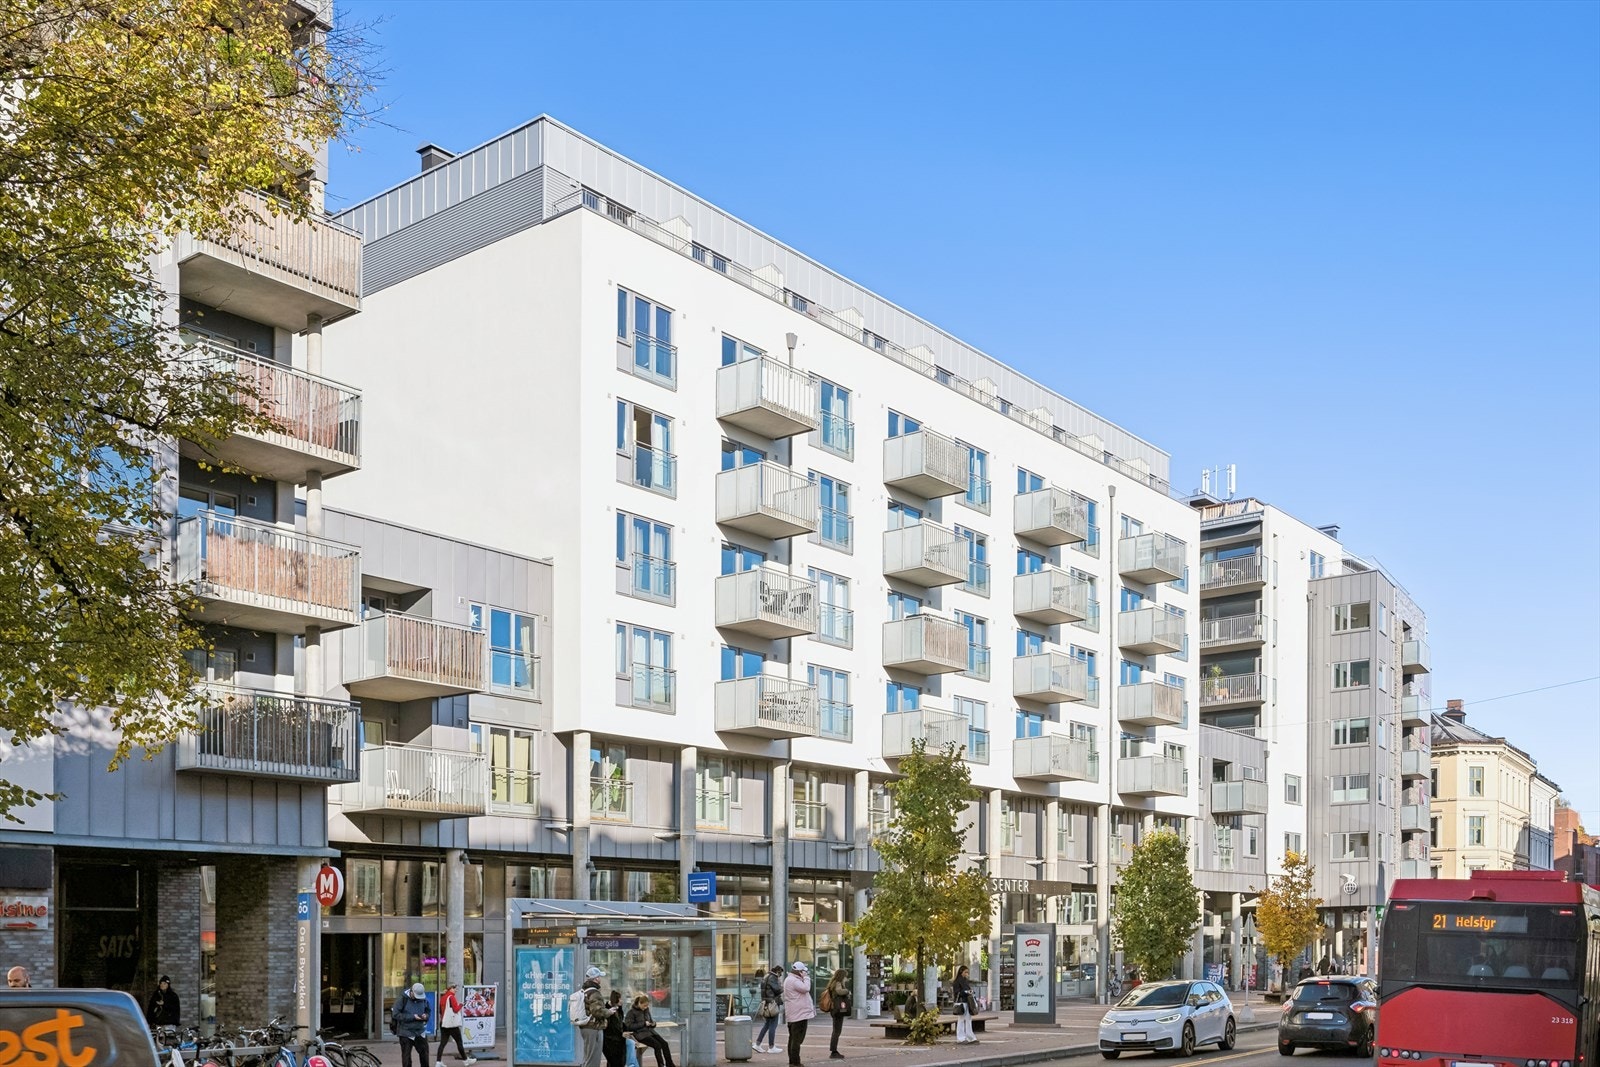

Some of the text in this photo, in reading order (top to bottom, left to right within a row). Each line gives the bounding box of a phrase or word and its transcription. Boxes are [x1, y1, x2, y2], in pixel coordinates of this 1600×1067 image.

[992, 879, 1029, 893] SENTER
[1433, 914, 1497, 931] 21 Helsfyr
[98, 935, 135, 958] SATS
[585, 937, 619, 949] Sannergata
[298, 957, 306, 1009] Bysykkel
[1552, 1016, 1560, 1024] 23
